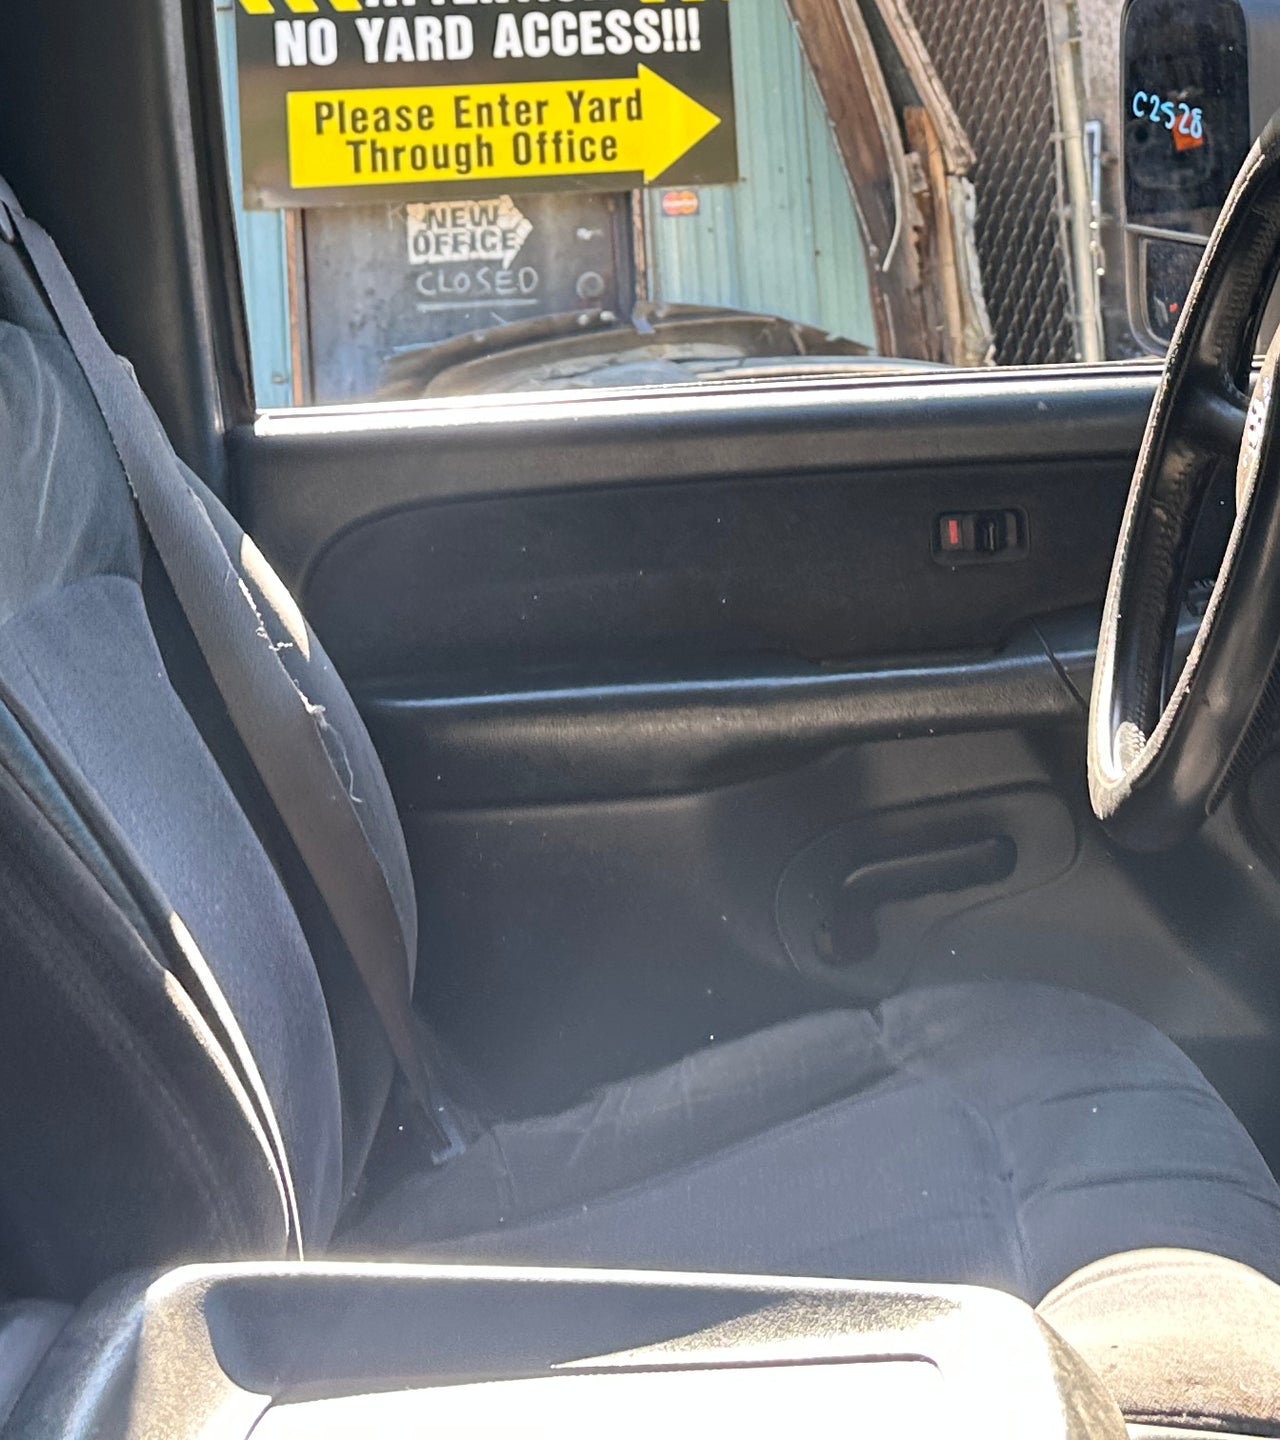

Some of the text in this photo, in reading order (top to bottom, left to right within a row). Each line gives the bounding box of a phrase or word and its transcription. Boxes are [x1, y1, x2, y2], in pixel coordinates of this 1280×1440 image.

[274, 6, 702, 67] NO YARD ACCESS!!!
[314, 88, 644, 136] Please Enter Yard
[1132, 90, 1203, 140] C2528
[346, 130, 618, 175] Through Office
[426, 205, 498, 229] NEW
[412, 228, 517, 257] OFFICE
[415, 266, 539, 297] CLOSED
